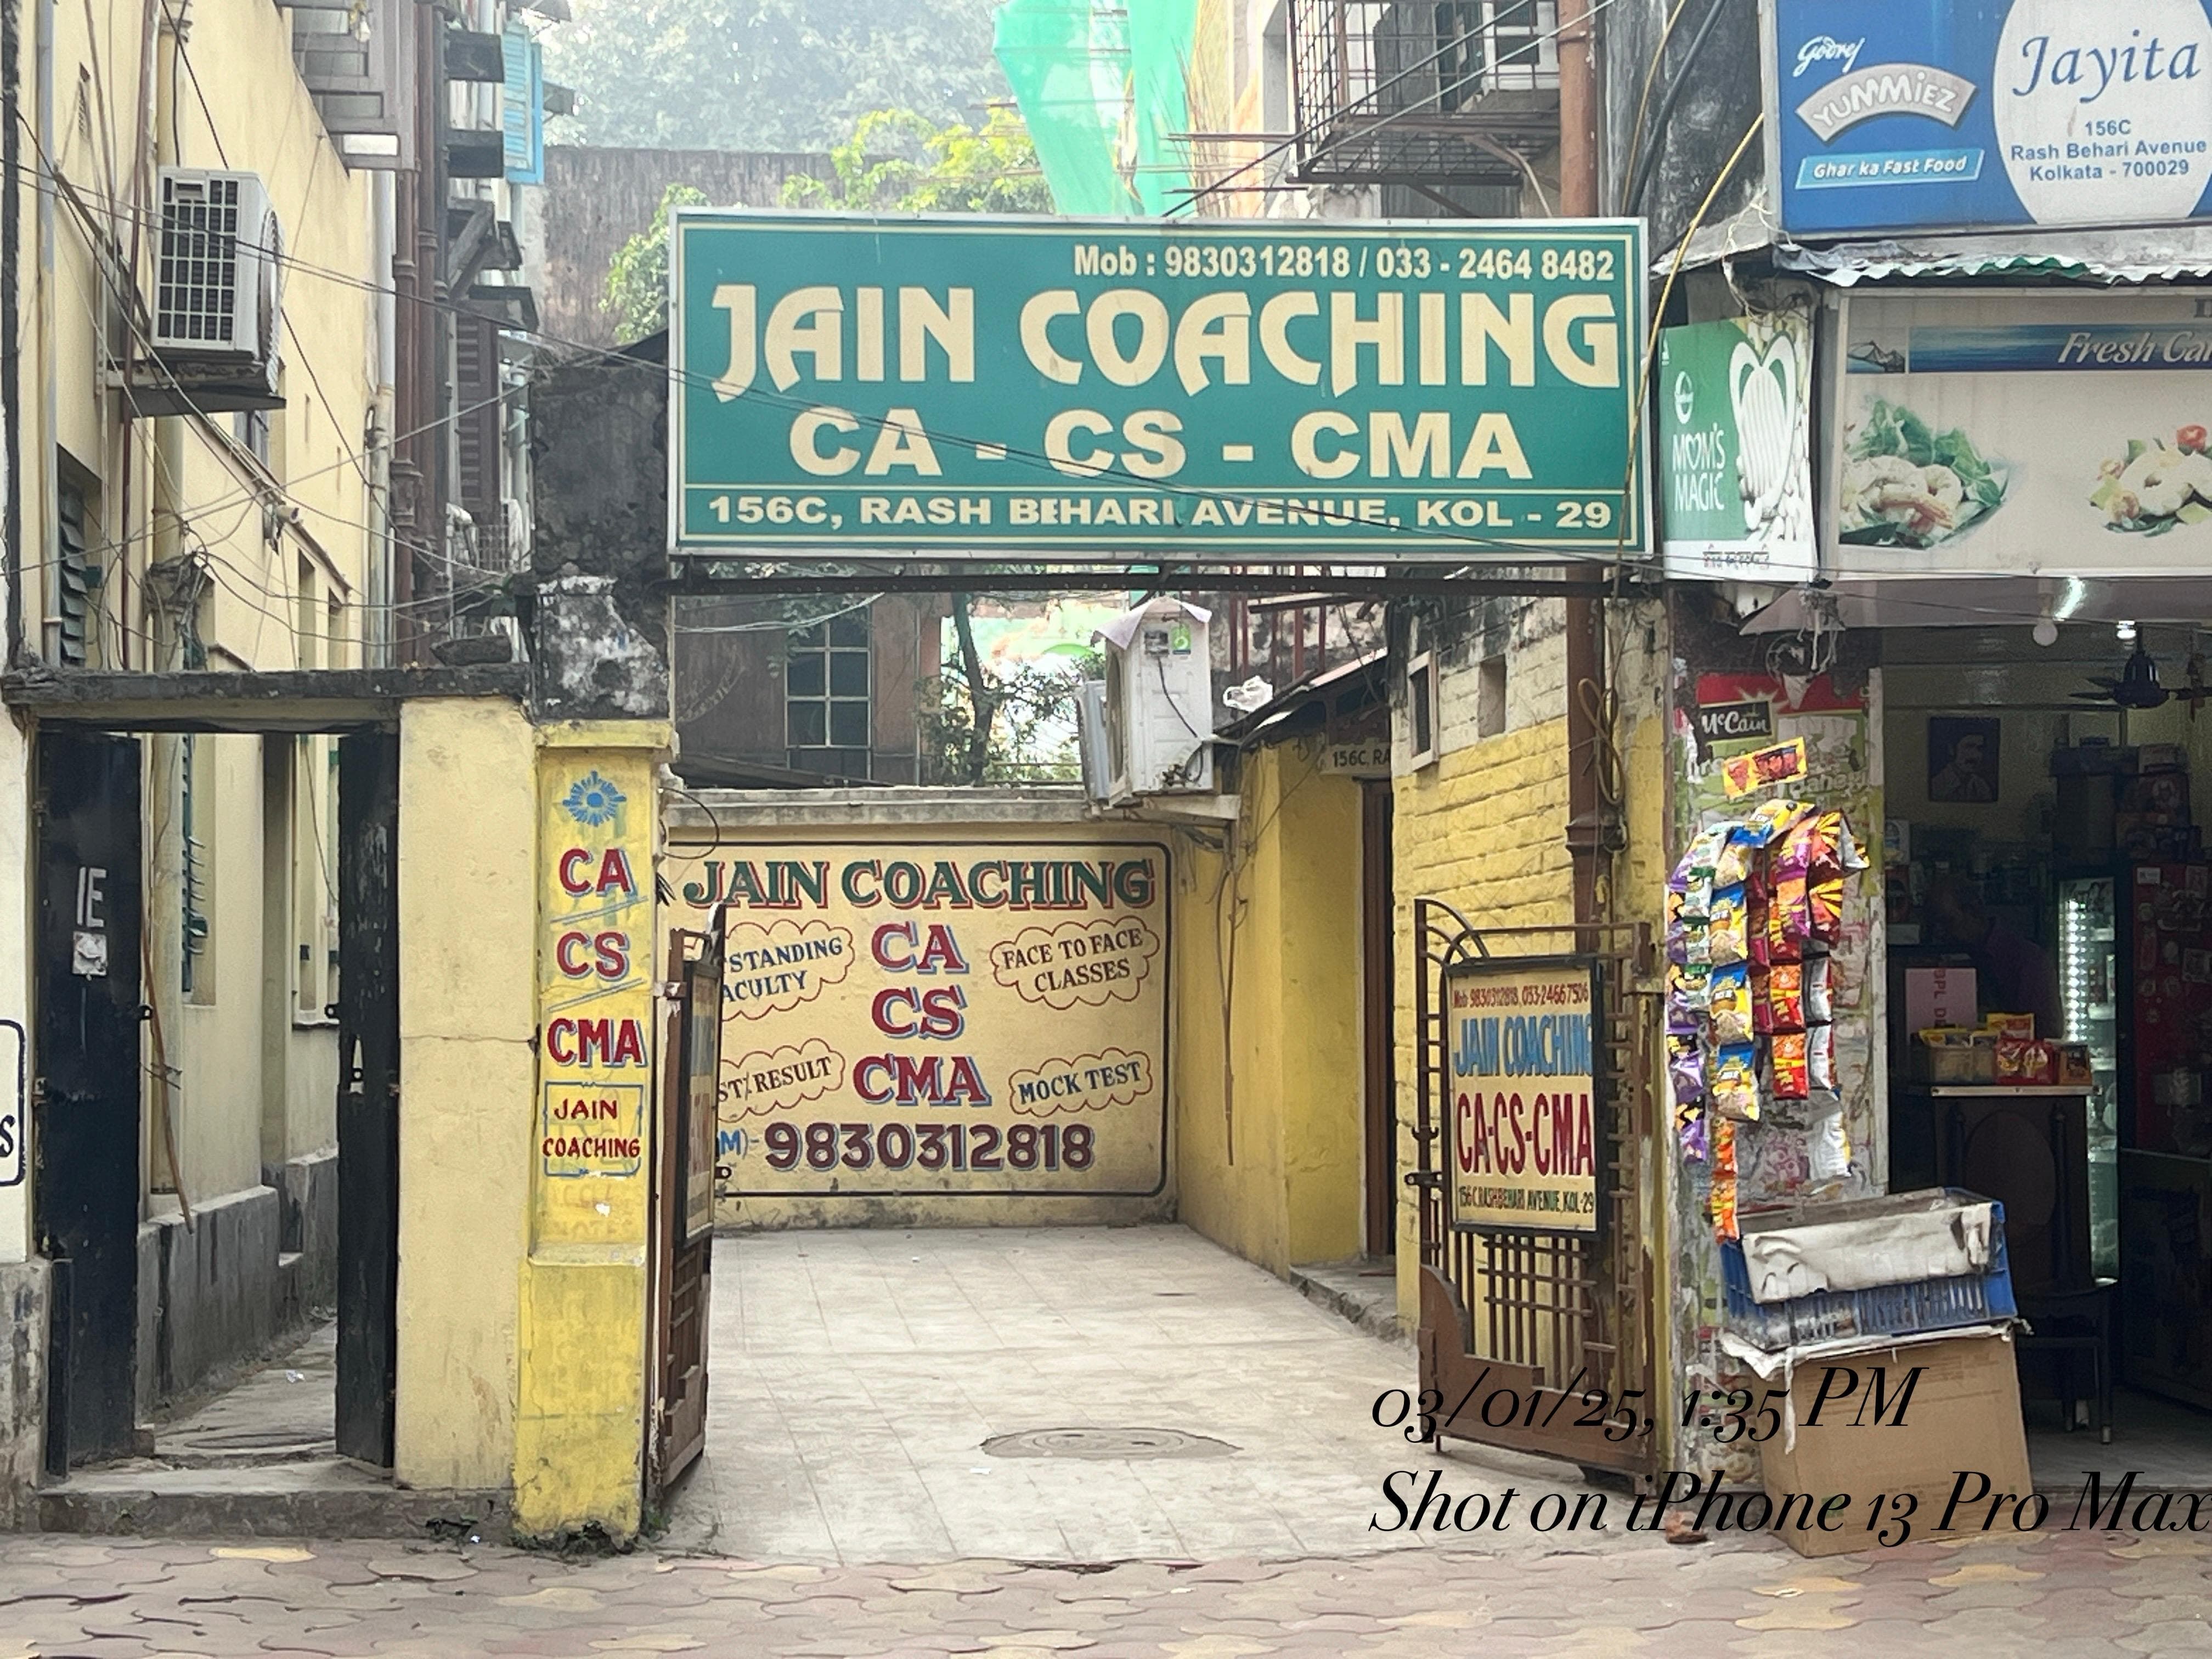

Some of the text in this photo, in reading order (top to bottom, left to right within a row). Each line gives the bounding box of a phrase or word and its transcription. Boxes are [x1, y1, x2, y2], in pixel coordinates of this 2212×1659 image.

[1793, 36, 1865, 77] Godrej
[2012, 29, 2201, 104] Jayita
[2085, 119, 2132, 137] 156C
[1813, 157, 1969, 180] Ghar ka Fast Food
[2011, 139, 2208, 162] Rash Behari Avenue
[2030, 162, 2103, 182] Kolkata
[2123, 160, 2190, 178] 700029
[1075, 245, 1137, 275] Mob
[1165, 245, 1351, 277] 9830312818
[1376, 247, 1431, 278] 033
[1459, 248, 1532, 279] 2464
[1541, 249, 1615, 280] 8482
[711, 284, 1620, 403] JAIN COACHING
[2058, 332, 2157, 363] Fresh
[789, 407, 943, 476] CA
[1044, 409, 1188, 478] CS
[1291, 410, 1533, 480] CMA
[1674, 472, 1725, 512] MAGIC
[709, 495, 844, 529] 156C,
[860, 498, 991, 526] RASH
[1009, 498, 1175, 527] BEHARI
[1190, 499, 1401, 531] AVENUE,
[1417, 500, 1514, 528] KOL
[1556, 501, 1612, 529] 29
[1701, 710, 1771, 735] McCain
[558, 848, 638, 897] CA
[682, 859, 1155, 911] JAIN COACHING
[556, 931, 631, 983] CS
[724, 936, 843, 973] STANDING
[872, 920, 970, 974] CA
[1002, 927, 1143, 970] FACE TO FACE
[1034, 958, 1131, 994] CLASSES
[872, 985, 968, 1040] CS
[547, 1018, 648, 1068] CMA
[1453, 1016, 1500, 1077] JAIN
[752, 1057, 831, 1093] RESULT
[853, 1053, 992, 1107] CMA
[1018, 1061, 1141, 1104] MOCK TEST
[554, 1097, 618, 1120] JAIN
[542, 1136, 642, 1159] COACHING
[764, 1121, 1096, 1172] 9830312818
